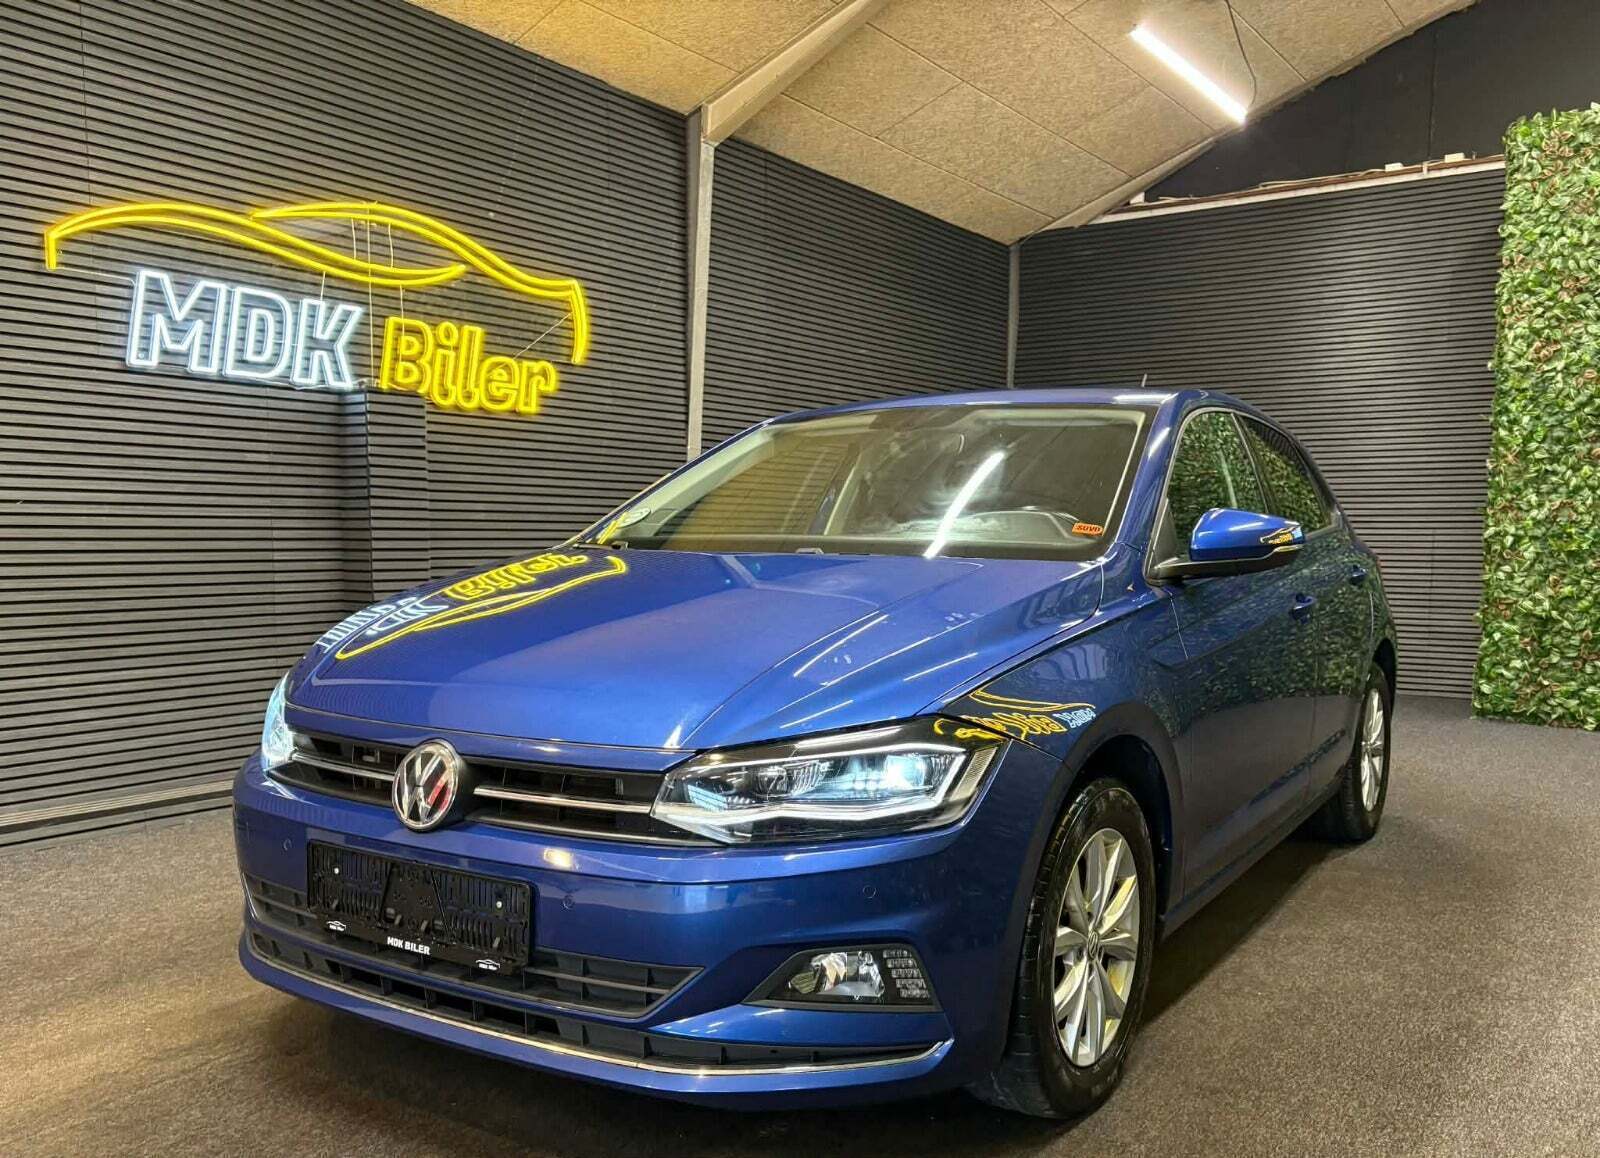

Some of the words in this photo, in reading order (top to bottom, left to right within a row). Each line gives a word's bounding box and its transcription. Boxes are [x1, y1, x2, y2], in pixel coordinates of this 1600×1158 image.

[124, 268, 364, 392] MDK
[378, 315, 558, 415] Biler
[386, 935, 404, 949] MDK
[404, 940, 431, 956] BILER
